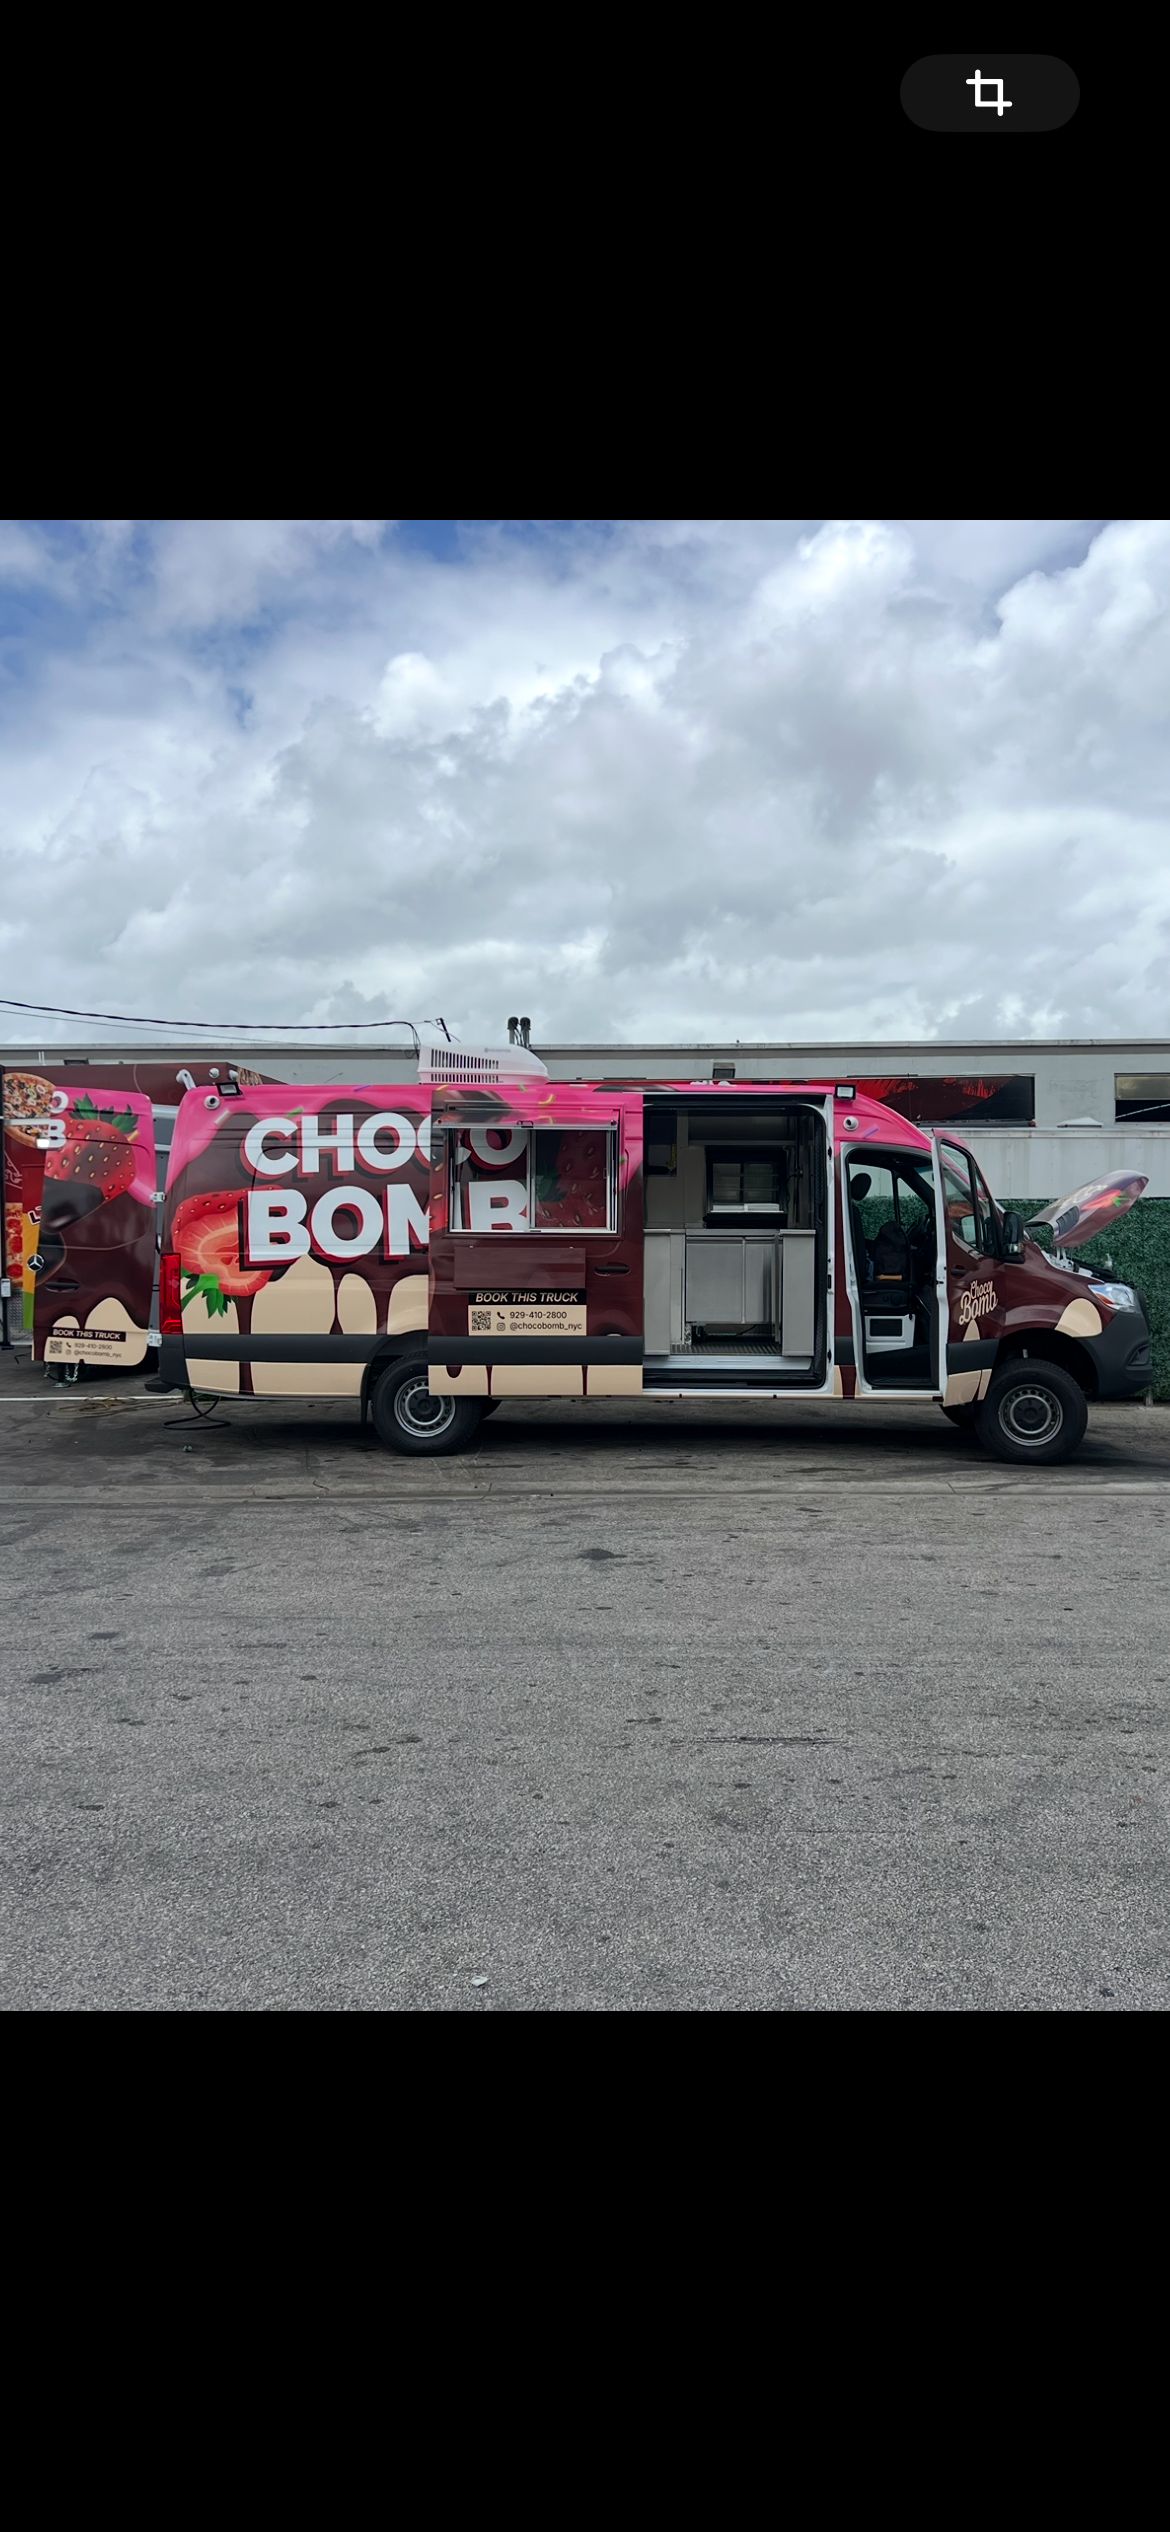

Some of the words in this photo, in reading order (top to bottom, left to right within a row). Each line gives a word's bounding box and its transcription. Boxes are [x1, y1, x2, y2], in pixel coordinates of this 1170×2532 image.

[970, 1280, 992, 1299] Choco
[475, 1293, 508, 1302] BOOK
[511, 1293, 537, 1302] THIS
[539, 1293, 579, 1302] TRUCK
[959, 1282, 998, 1325] Bomb
[509, 1311, 567, 1319] 929-410-2800
[510, 1322, 582, 1331] @chocobomb_nyc
[76, 1330, 93, 1338] THIS
[95, 1331, 121, 1339] TRUCK
